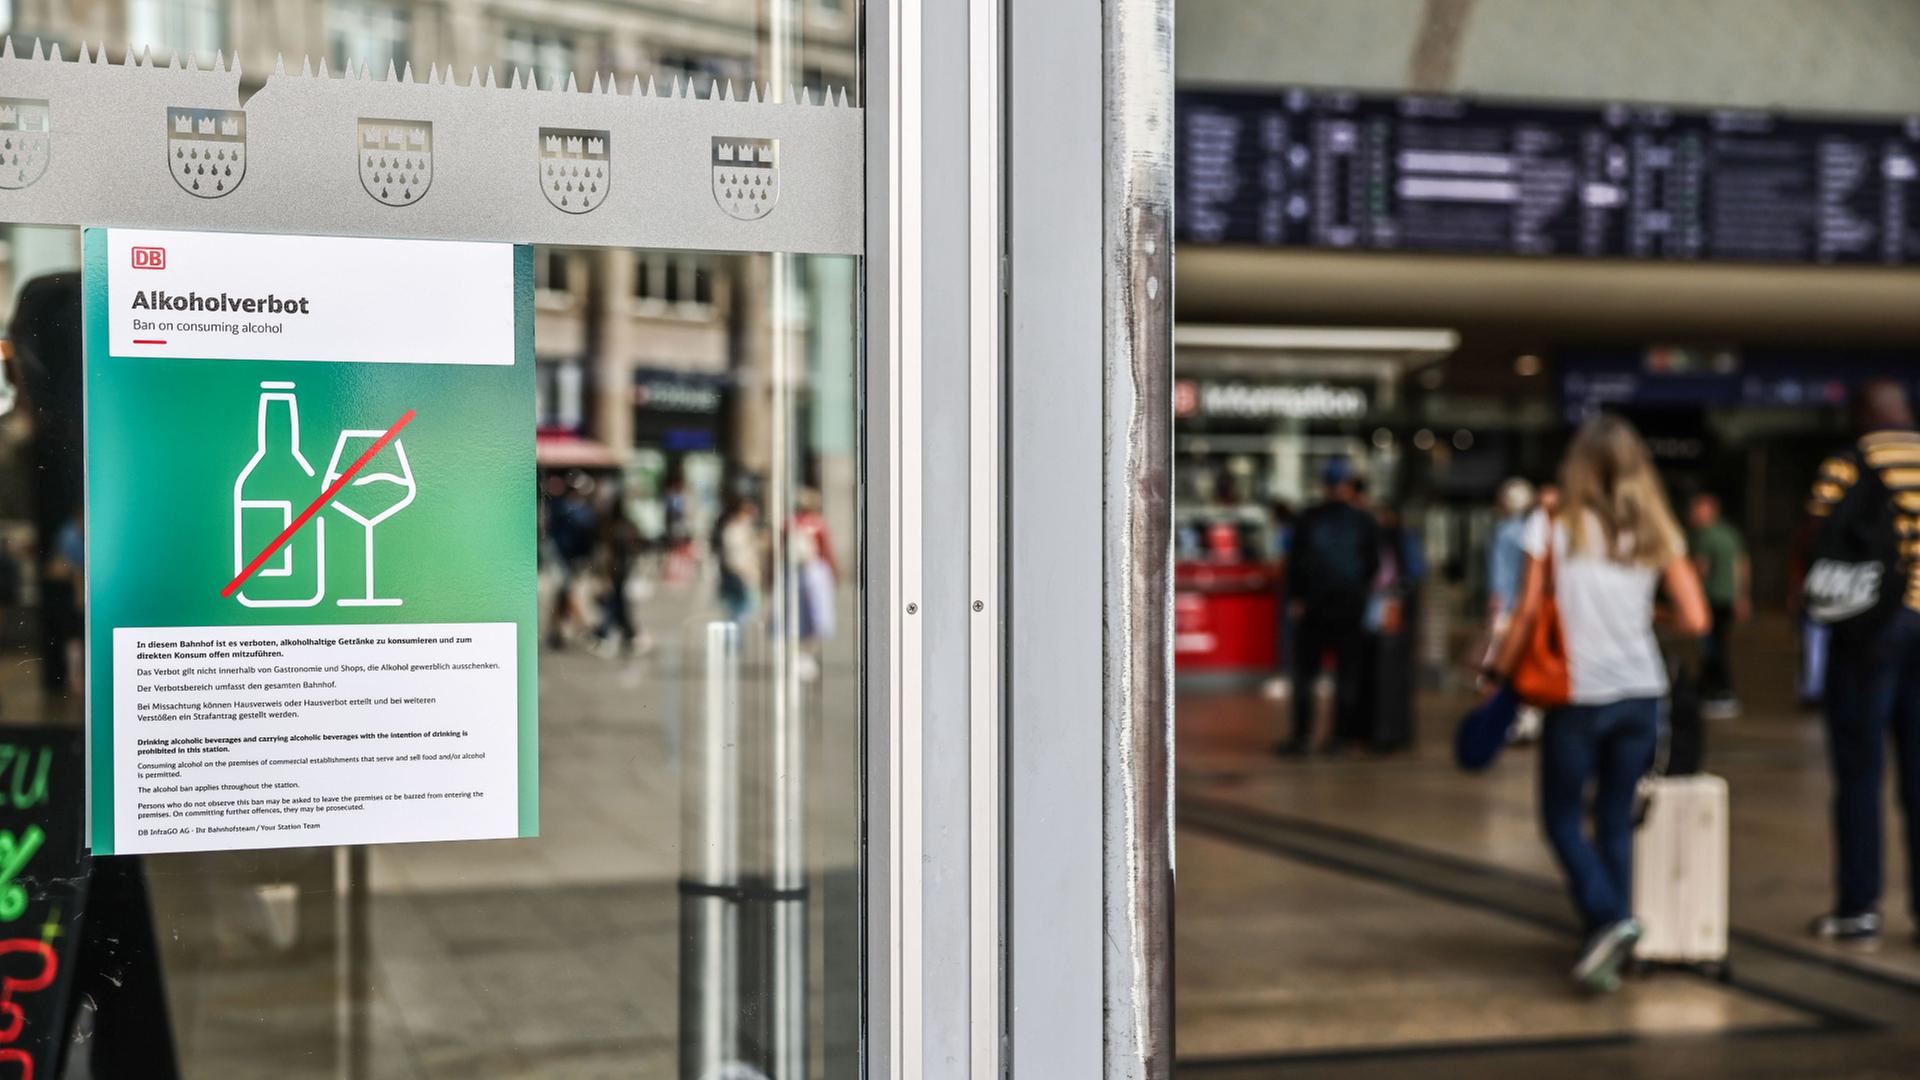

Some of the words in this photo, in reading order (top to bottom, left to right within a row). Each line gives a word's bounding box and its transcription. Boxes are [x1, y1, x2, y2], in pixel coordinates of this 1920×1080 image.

[135, 249, 163, 267] DB
[131, 290, 310, 314] Alkoholverbot
[132, 318, 156, 330] Ban
[158, 322, 174, 331] on
[176, 321, 240, 335] consuming
[241, 322, 283, 334] alcohol
[136, 641, 147, 649] In
[147, 640, 178, 648] diesem
[179, 639, 215, 648] Bahnhof
[215, 639, 227, 647] ist
[227, 640, 238, 648] es
[239, 639, 279, 647] verboten,
[279, 637, 337, 647] alkoholhaltige
[337, 637, 375, 645] Getränke
[387, 636, 438, 644] konsumieren
[438, 636, 455, 644] und
[136, 651, 173, 659] direkten
[173, 651, 208, 659] Konsum
[208, 650, 231, 658] offen
[231, 649, 285, 657] mitzuführen.
[136, 668, 153, 676] Das
[153, 667, 181, 676] Verbot
[181, 667, 196, 677] gilt
[196, 666, 217, 675] nicht
[218, 665, 257, 674] innerhalb
[273, 664, 323, 673] Gastronomie
[323, 664, 340, 672] und
[340, 664, 367, 673] Shops,
[366, 663, 380, 671] die
[380, 663, 410, 671] Alkohol
[409, 662, 451, 672] gewerblich
[451, 662, 501, 670] ausschenken.
[136, 684, 153, 692] Der
[153, 683, 214, 692] Verbotsbereich
[214, 682, 246, 690] umfasst
[247, 682, 263, 690] den
[263, 682, 302, 691] gesamten
[302, 680, 337, 688] Bahnhof.
[137, 702, 151, 710] Bei
[151, 701, 202, 711] Missachtung
[202, 701, 233, 709] können
[233, 699, 283, 708] Hausverweis
[283, 699, 303, 707] oder
[303, 698, 348, 706] Hausverbot
[348, 697, 373, 705] erteilt
[373, 697, 389, 705] und
[389, 696, 403, 704] bei
[403, 696, 437, 704] weiteren
[136, 713, 178, 721] Verstößen
[178, 712, 192, 720] ein
[192, 711, 238, 721] Strafantrag
[238, 710, 267, 720] gestellt
[268, 710, 300, 718] werden.
[137, 737, 170, 746] Drinking
[170, 737, 204, 745] alcoholic
[204, 737, 243, 745] beverages
[242, 735, 258, 743] and
[257, 735, 289, 744] carrying
[289, 733, 322, 741] alcoholic
[322, 733, 359, 742] beverages
[359, 732, 376, 740] with
[376, 732, 390, 740] the
[390, 731, 423, 739] intention
[423, 730, 432, 738] of
[431, 730, 462, 739] drinking
[137, 745, 177, 756] prohibited
[177, 746, 186, 754] in
[186, 746, 201, 754] this
[202, 745, 231, 753] station.
[136, 761, 177, 771] Consuming
[177, 760, 204, 768] alcohol
[214, 759, 228, 767] the
[227, 759, 260, 768] premises
[259, 758, 269, 766] of
[268, 757, 309, 766] commercial
[309, 756, 360, 764] establishments
[360, 755, 375, 763] that
[395, 754, 409, 762] and
[409, 753, 422, 761] sell
[421, 753, 438, 761] food
[438, 752, 461, 760] and/or
[461, 751, 486, 759] alcohol
[144, 769, 183, 779] permitted.
[137, 786, 152, 794] The
[152, 783, 179, 793] alcohol
[179, 784, 194, 792] ban
[194, 783, 220, 792] applies
[220, 783, 260, 792] throughout
[260, 781, 273, 789] the
[273, 781, 301, 789] station.
[137, 801, 166, 810] Persons
[166, 800, 183, 808] who
[182, 800, 194, 808] do
[193, 800, 207, 808] not
[207, 799, 236, 807] observe
[236, 798, 251, 806] this
[250, 798, 265, 806] ban
[281, 797, 291, 805] be
[291, 796, 312, 804] asked
[312, 796, 321, 804] to
[321, 795, 340, 803] leave
[340, 795, 353, 803] the
[353, 794, 384, 804] premises
[393, 793, 403, 801] be
[403, 792, 427, 800] barred
[426, 791, 444, 799] from
[443, 791, 473, 800] entering
[137, 810, 172, 820] premises.
[172, 809, 184, 817] On
[184, 808, 225, 817] committing
[225, 807, 251, 815] further
[251, 806, 283, 814] offences,
[283, 806, 300, 815] they
[299, 806, 315, 815] may
[315, 804, 325, 812] be
[325, 803, 365, 812] prosecuted.
[137, 828, 149, 836] DB
[150, 826, 179, 835] InfraGO
[178, 826, 191, 834] AG
[195, 826, 207, 834] Ihr
[277, 823, 302, 831] Station
[302, 822, 321, 830] Team
